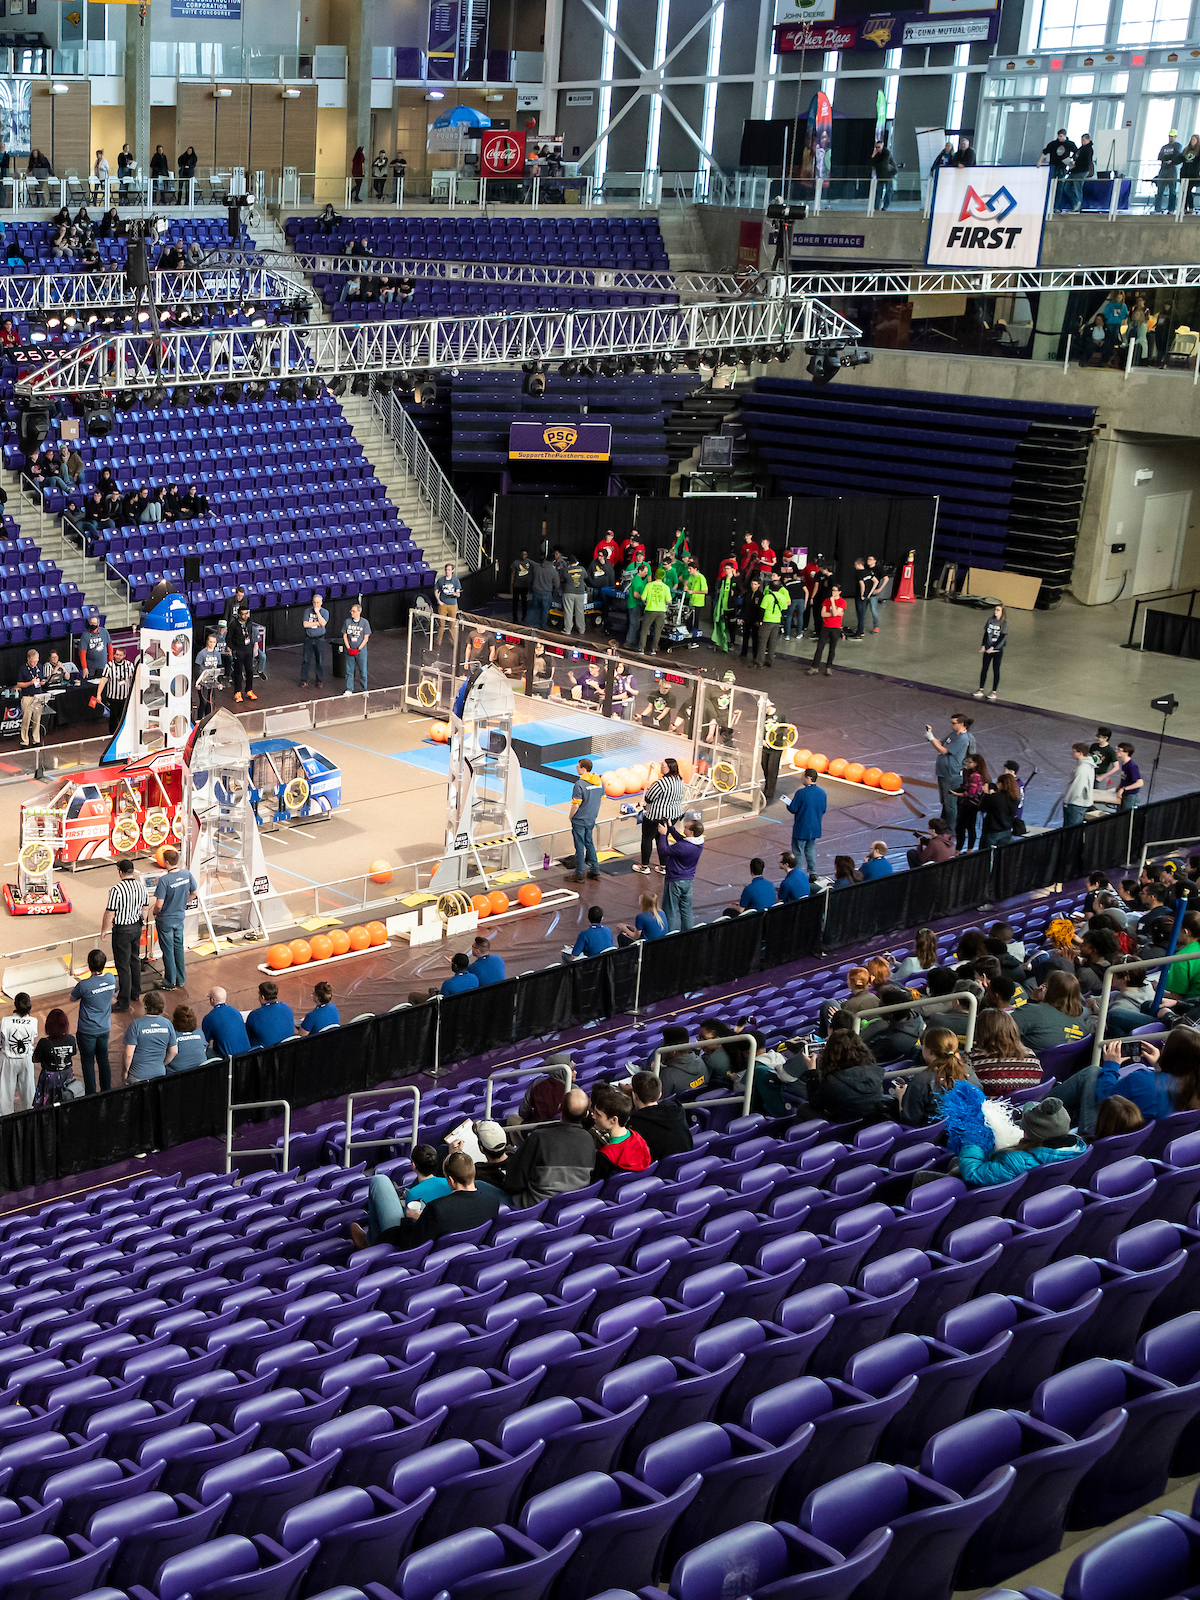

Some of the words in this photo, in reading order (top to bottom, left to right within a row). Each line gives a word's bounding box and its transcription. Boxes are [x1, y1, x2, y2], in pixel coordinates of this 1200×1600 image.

[863, 18, 896, 34] UNI
[938, 27, 965, 35] MUTUAL
[967, 26, 988, 34] GROUP
[793, 30, 824, 46] Oher
[825, 29, 851, 44] Place
[947, 227, 1022, 249] FIRST
[739, 246, 757, 262] WELLS
[547, 432, 574, 442] PSC
[307, 763, 316, 774] 19
[313, 784, 326, 792] FIRST
[92, 804, 104, 814] 19
[65, 830, 85, 838] FIRST
[87, 826, 107, 836] 2019
[27, 905, 54, 914] 2957
[92, 984, 116, 995] VOLUNTEER
